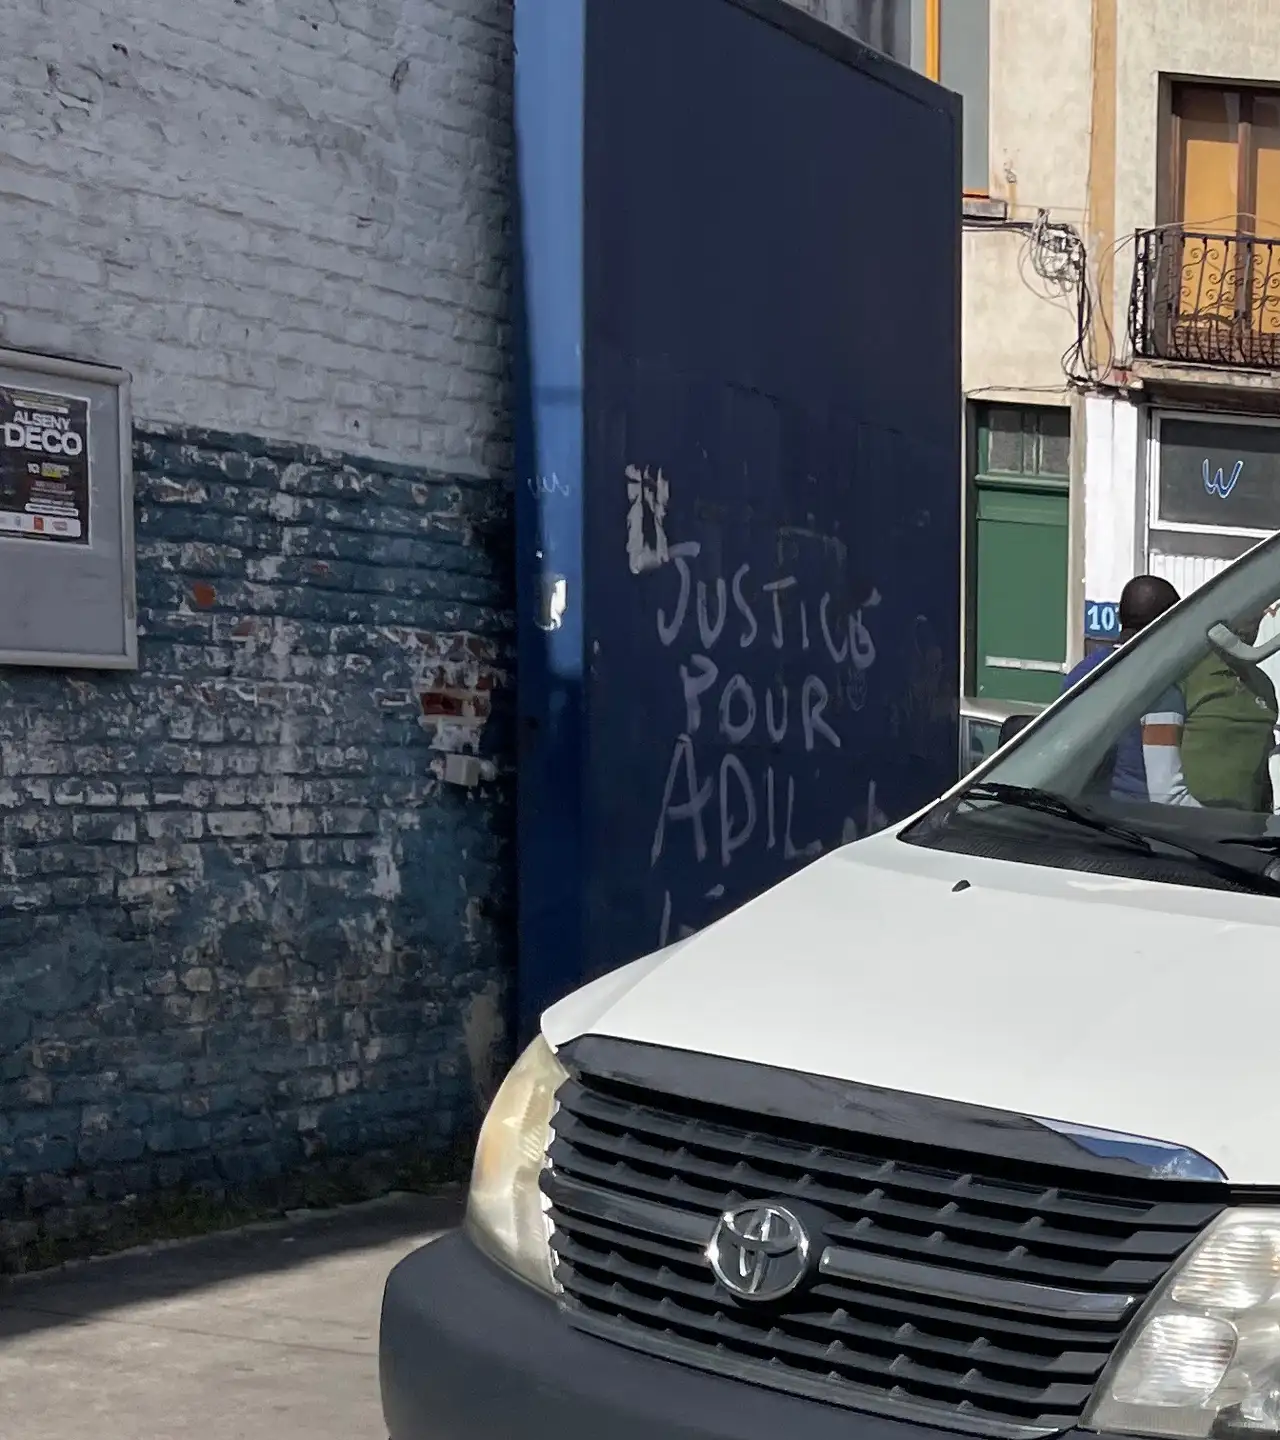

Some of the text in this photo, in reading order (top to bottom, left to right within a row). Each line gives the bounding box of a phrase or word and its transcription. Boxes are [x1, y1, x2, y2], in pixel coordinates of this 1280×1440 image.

[4, 421, 83, 456] DECO
[13, 410, 71, 431] ALSENY
[680, 654, 841, 752] POUR
[651, 733, 823, 868] ADIL
